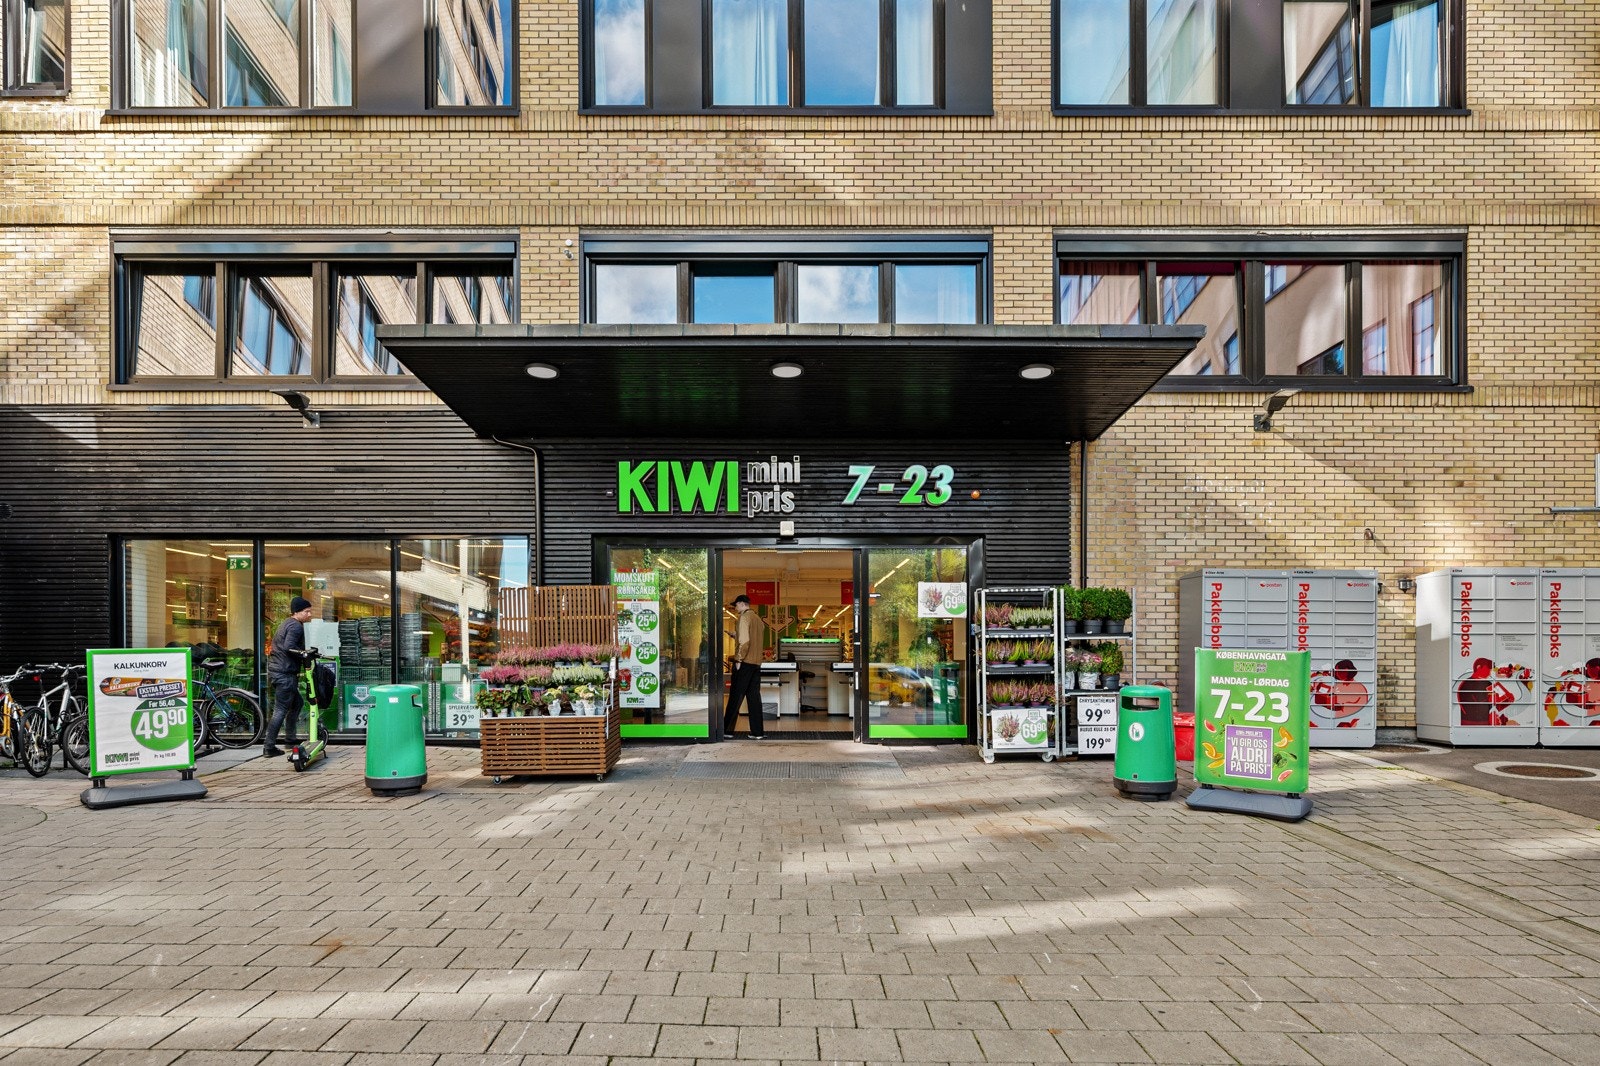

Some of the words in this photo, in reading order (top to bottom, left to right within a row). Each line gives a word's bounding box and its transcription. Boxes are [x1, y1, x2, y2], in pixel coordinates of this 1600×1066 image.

[747, 456, 800, 483] mini
[618, 460, 741, 515] KIWI
[747, 485, 795, 518] pris
[614, 572, 655, 583] MOMSKUTT
[1460, 582, 1472, 657] Pakkeboks
[1550, 582, 1561, 658] Pakkeboks
[1216, 651, 1287, 660] KØBENHAVNGATA
[113, 661, 167, 669] KALKUNKORV
[139, 686, 159, 694] EKSTRA
[159, 682, 180, 691] PRESSET
[1211, 676, 1248, 685] MANDAG
[1254, 678, 1290, 687] LØRDAG
[1211, 689, 1290, 724] 7-23
[1240, 738, 1252, 748] GIR
[1254, 739, 1268, 749] OSS
[105, 752, 128, 764] KIWI
[1231, 746, 1268, 764] ALDRI
